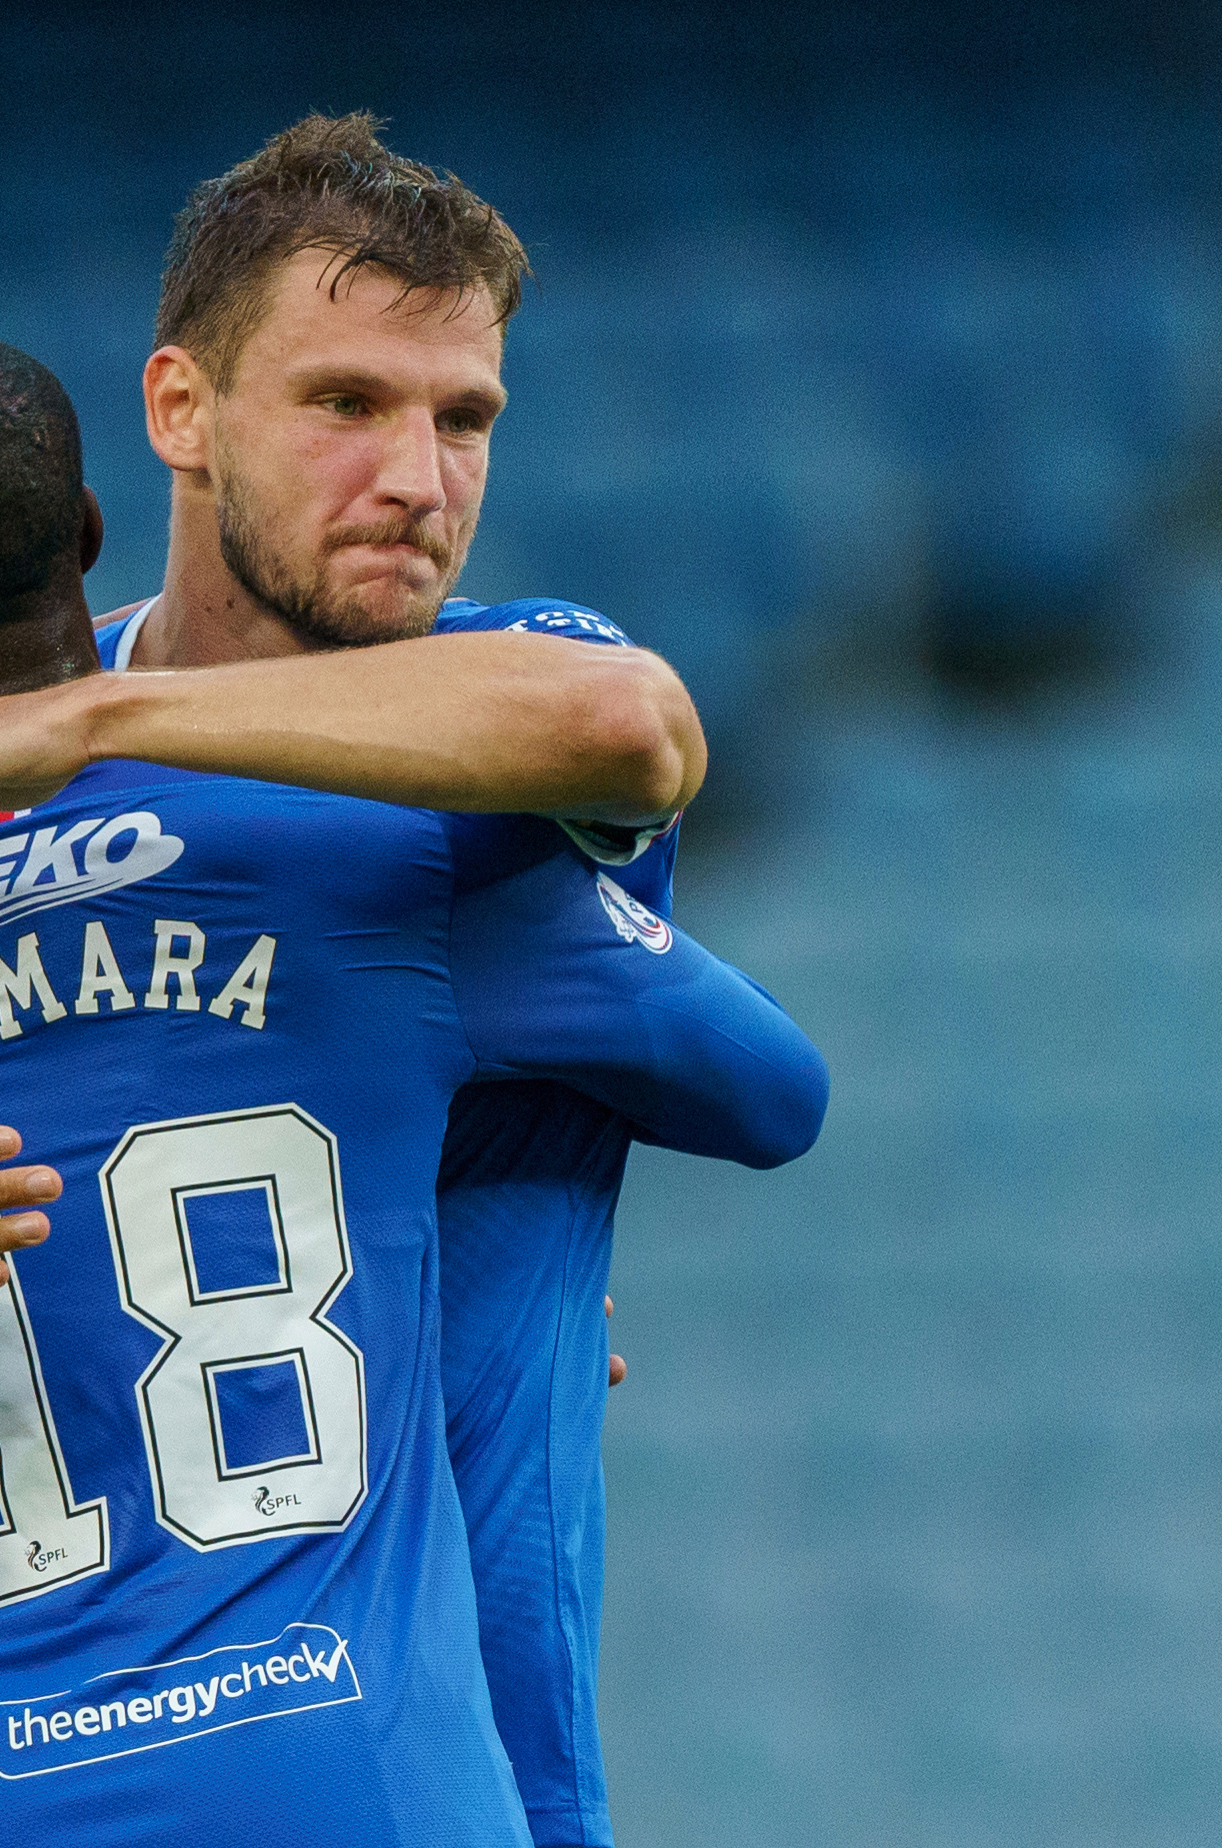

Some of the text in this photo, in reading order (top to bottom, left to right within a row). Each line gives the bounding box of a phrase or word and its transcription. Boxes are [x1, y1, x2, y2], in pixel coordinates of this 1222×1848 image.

[266, 1493, 302, 1510] SPFL
[38, 1547, 69, 1566] SPFL
[7, 1642, 334, 1750] theenergycheck
